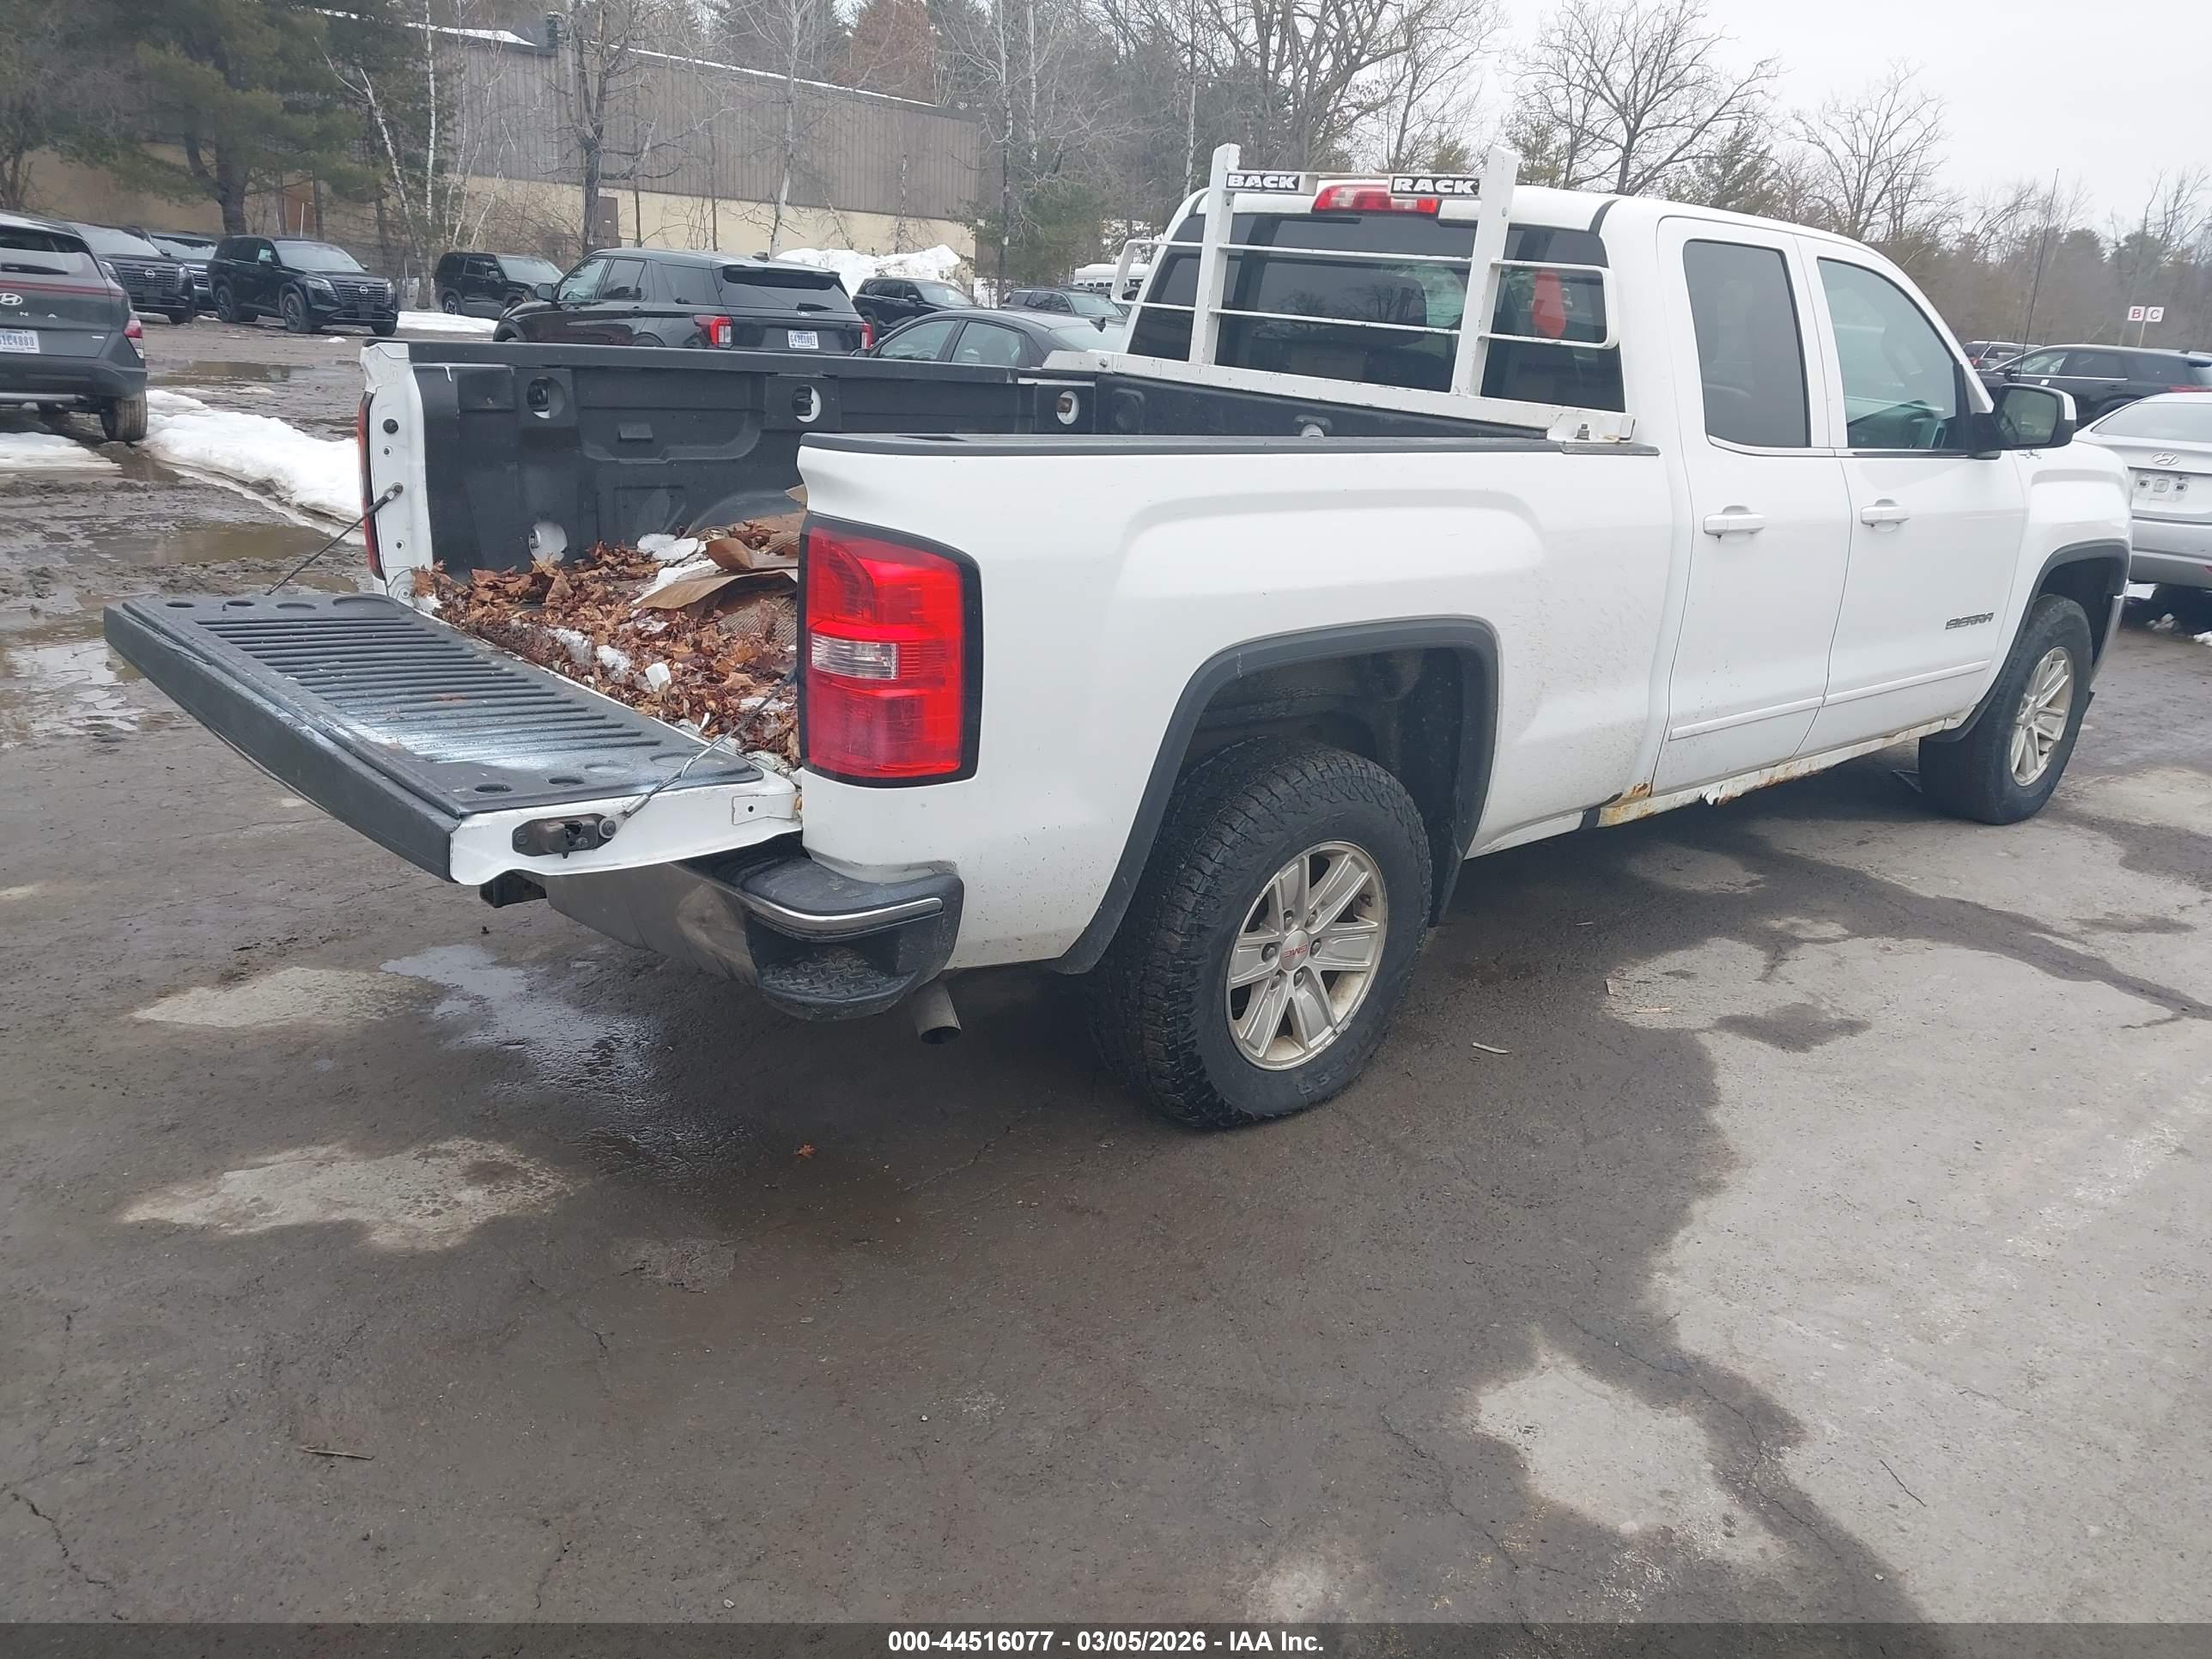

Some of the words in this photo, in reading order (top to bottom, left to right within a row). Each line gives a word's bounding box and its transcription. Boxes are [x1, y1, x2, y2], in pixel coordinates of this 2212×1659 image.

[1226, 173, 1297, 189] BACK
[1392, 177, 1479, 194] RACK
[2131, 309, 2142, 319] B
[2150, 309, 2160, 319] C
[1945, 611, 1994, 630] SIERRA
[1284, 944, 1307, 958] GMC
